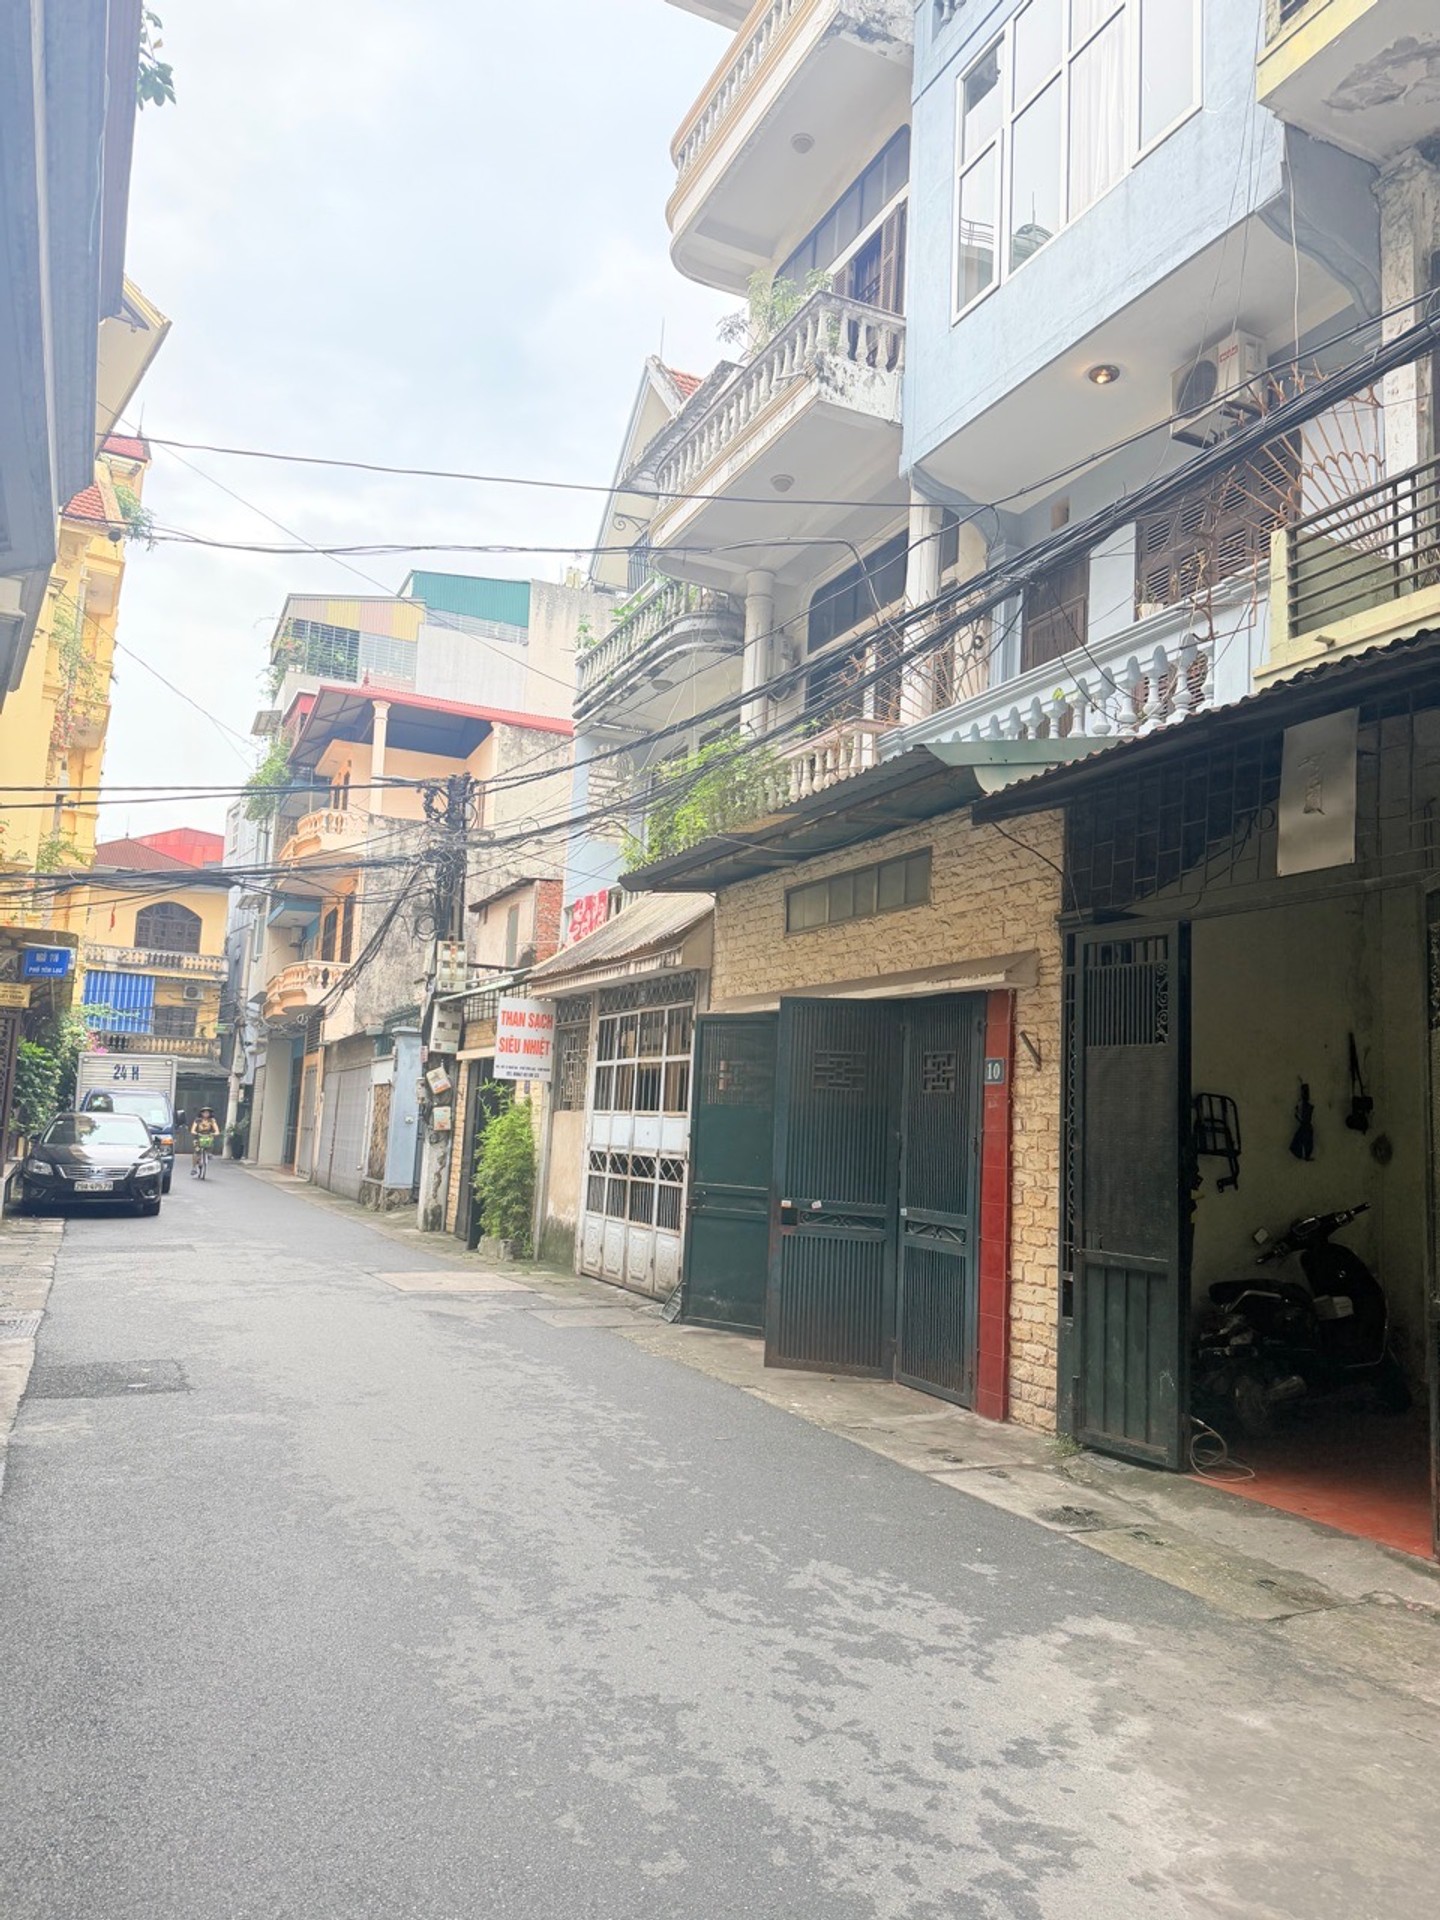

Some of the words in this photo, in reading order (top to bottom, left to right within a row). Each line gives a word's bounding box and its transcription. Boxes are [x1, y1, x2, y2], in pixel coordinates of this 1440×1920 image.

[501, 1010, 525, 1027] THAN
[528, 1012, 553, 1031] SẠCH
[499, 1034, 520, 1053] SIÊU
[523, 1036, 550, 1059] NHIỆT
[113, 1063, 127, 1080] 24
[131, 1064, 139, 1080] H
[987, 1062, 1000, 1080] 10
